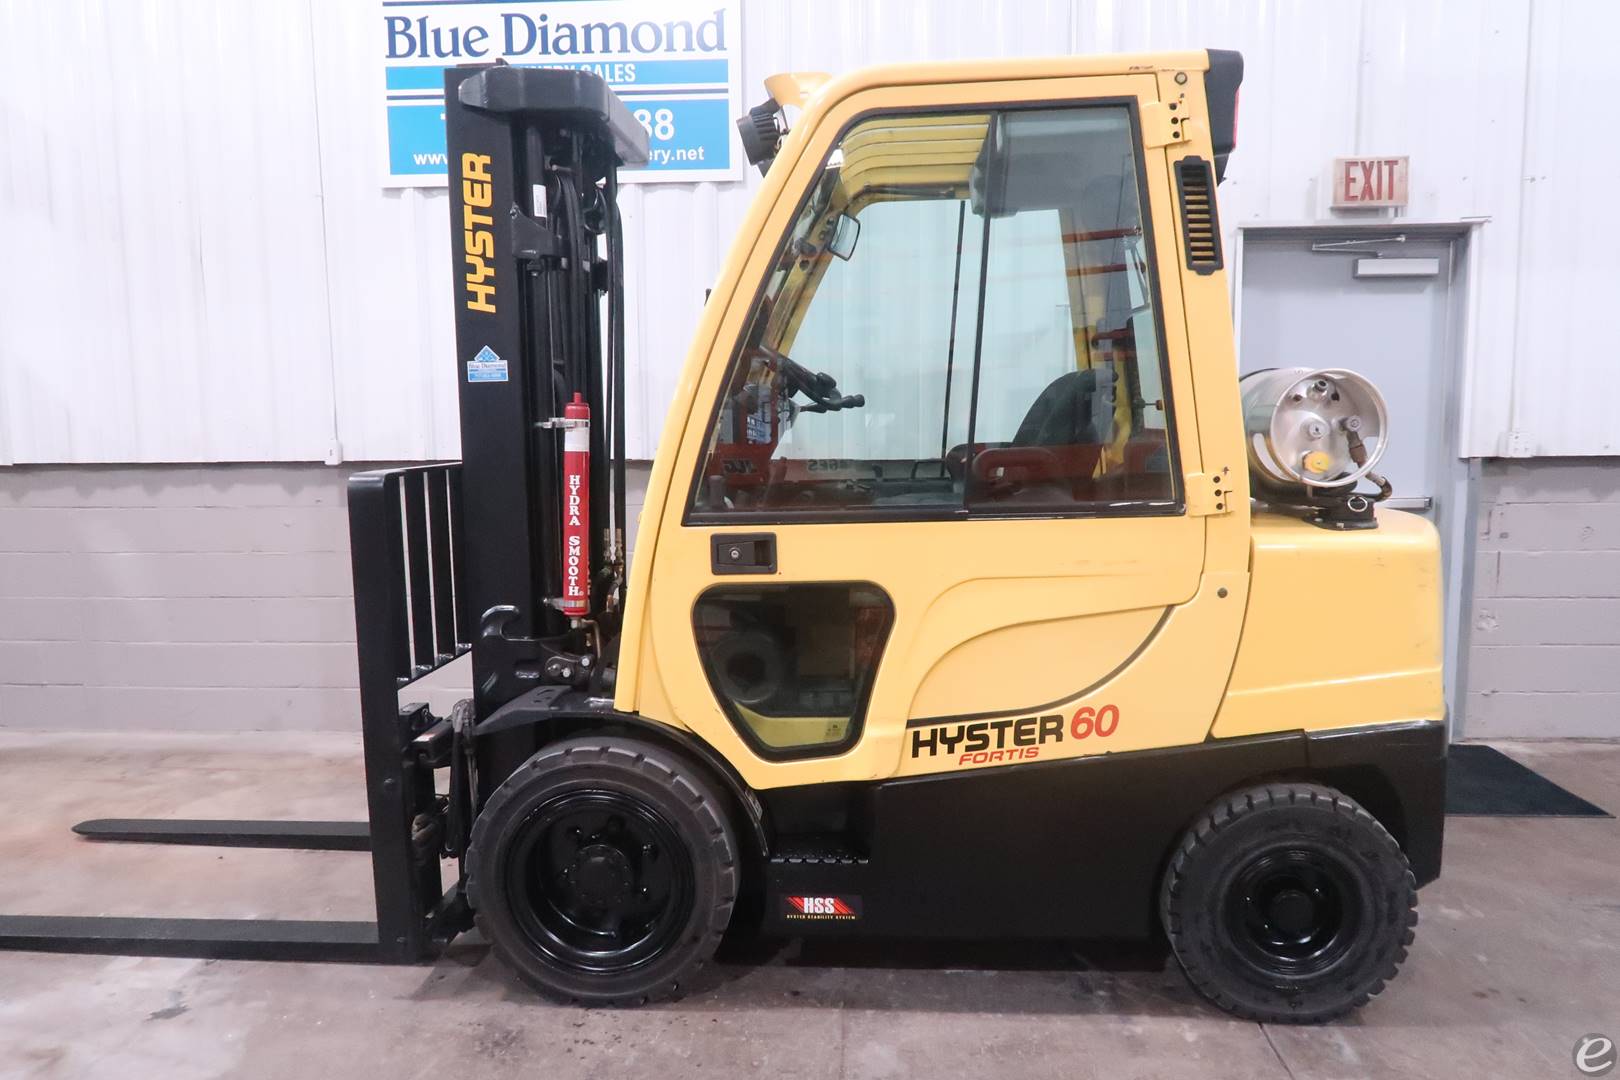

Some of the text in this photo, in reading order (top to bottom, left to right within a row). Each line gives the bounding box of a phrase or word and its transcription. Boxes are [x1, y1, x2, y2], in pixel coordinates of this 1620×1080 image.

[384, 8, 727, 59] Blue Diamond
[649, 146, 705, 165] ry.net
[1343, 160, 1399, 202] EXIT
[462, 152, 496, 313] HYSTER
[569, 475, 580, 526] HYDRA
[911, 704, 1120, 759] HYSTER 60
[958, 746, 1040, 766] FORTIS
[803, 897, 835, 914] HSS
